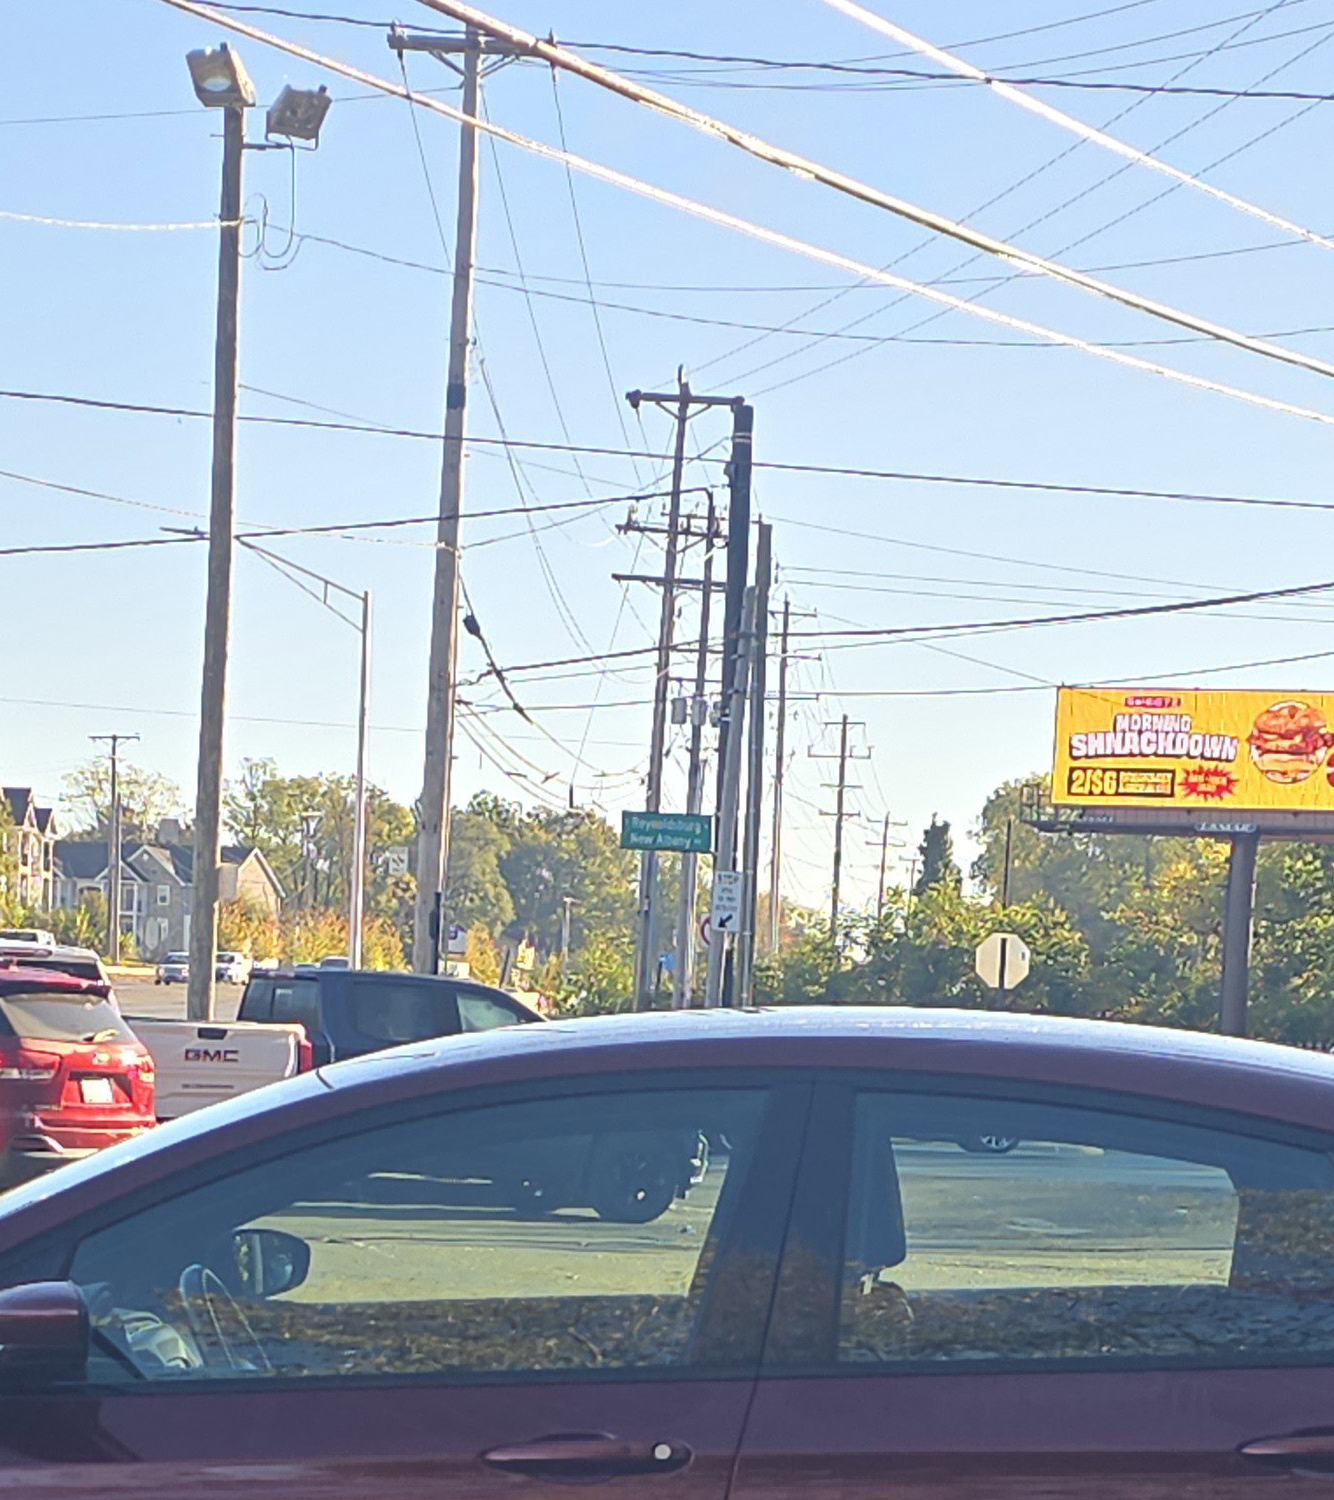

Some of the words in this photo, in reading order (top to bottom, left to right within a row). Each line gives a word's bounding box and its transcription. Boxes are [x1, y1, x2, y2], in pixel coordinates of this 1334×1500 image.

[1114, 713, 1193, 733] MORNING
[1070, 769, 1118, 795] 2/$6
[184, 1048, 240, 1063] GMC
